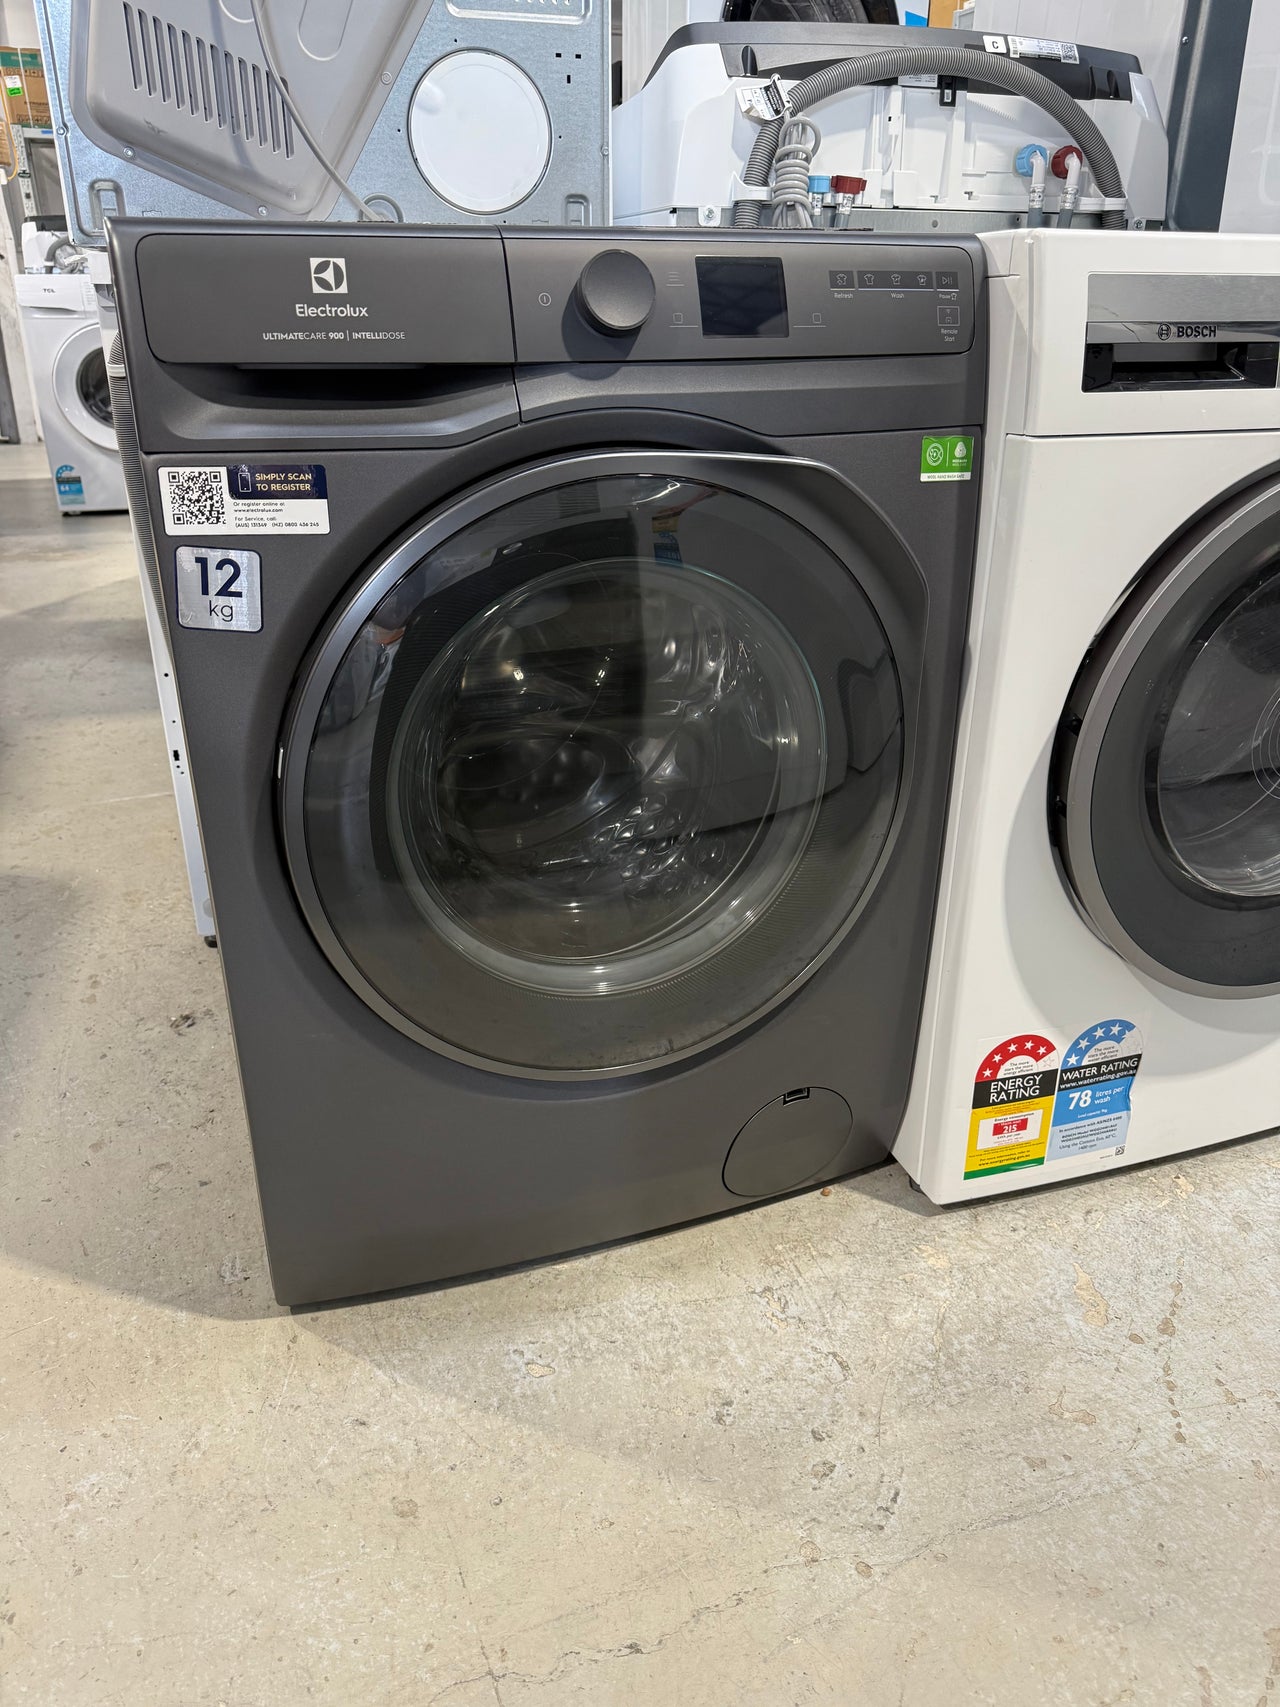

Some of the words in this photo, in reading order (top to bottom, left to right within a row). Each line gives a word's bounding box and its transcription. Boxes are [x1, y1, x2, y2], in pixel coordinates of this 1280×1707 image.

[992, 40, 999, 50] C
[295, 303, 369, 317] Electrolux
[262, 332, 327, 340] ULTIMATECARE
[328, 332, 344, 340] 900
[352, 331, 406, 340] INTELLIDOSE
[1176, 325, 1217, 338] BOSCH
[194, 556, 243, 598] 12
[209, 600, 234, 622] kg
[1062, 1066, 1098, 1081] WATER
[1100, 1058, 1139, 1074] RATING
[990, 1074, 1043, 1092] ENERGY
[990, 1087, 1040, 1104] RATING
[1096, 1089, 1112, 1098] litres
[1112, 1086, 1125, 1095] per
[1068, 1090, 1093, 1110] 78
[1094, 1096, 1111, 1105] wash
[1002, 1124, 1018, 1134] 215
